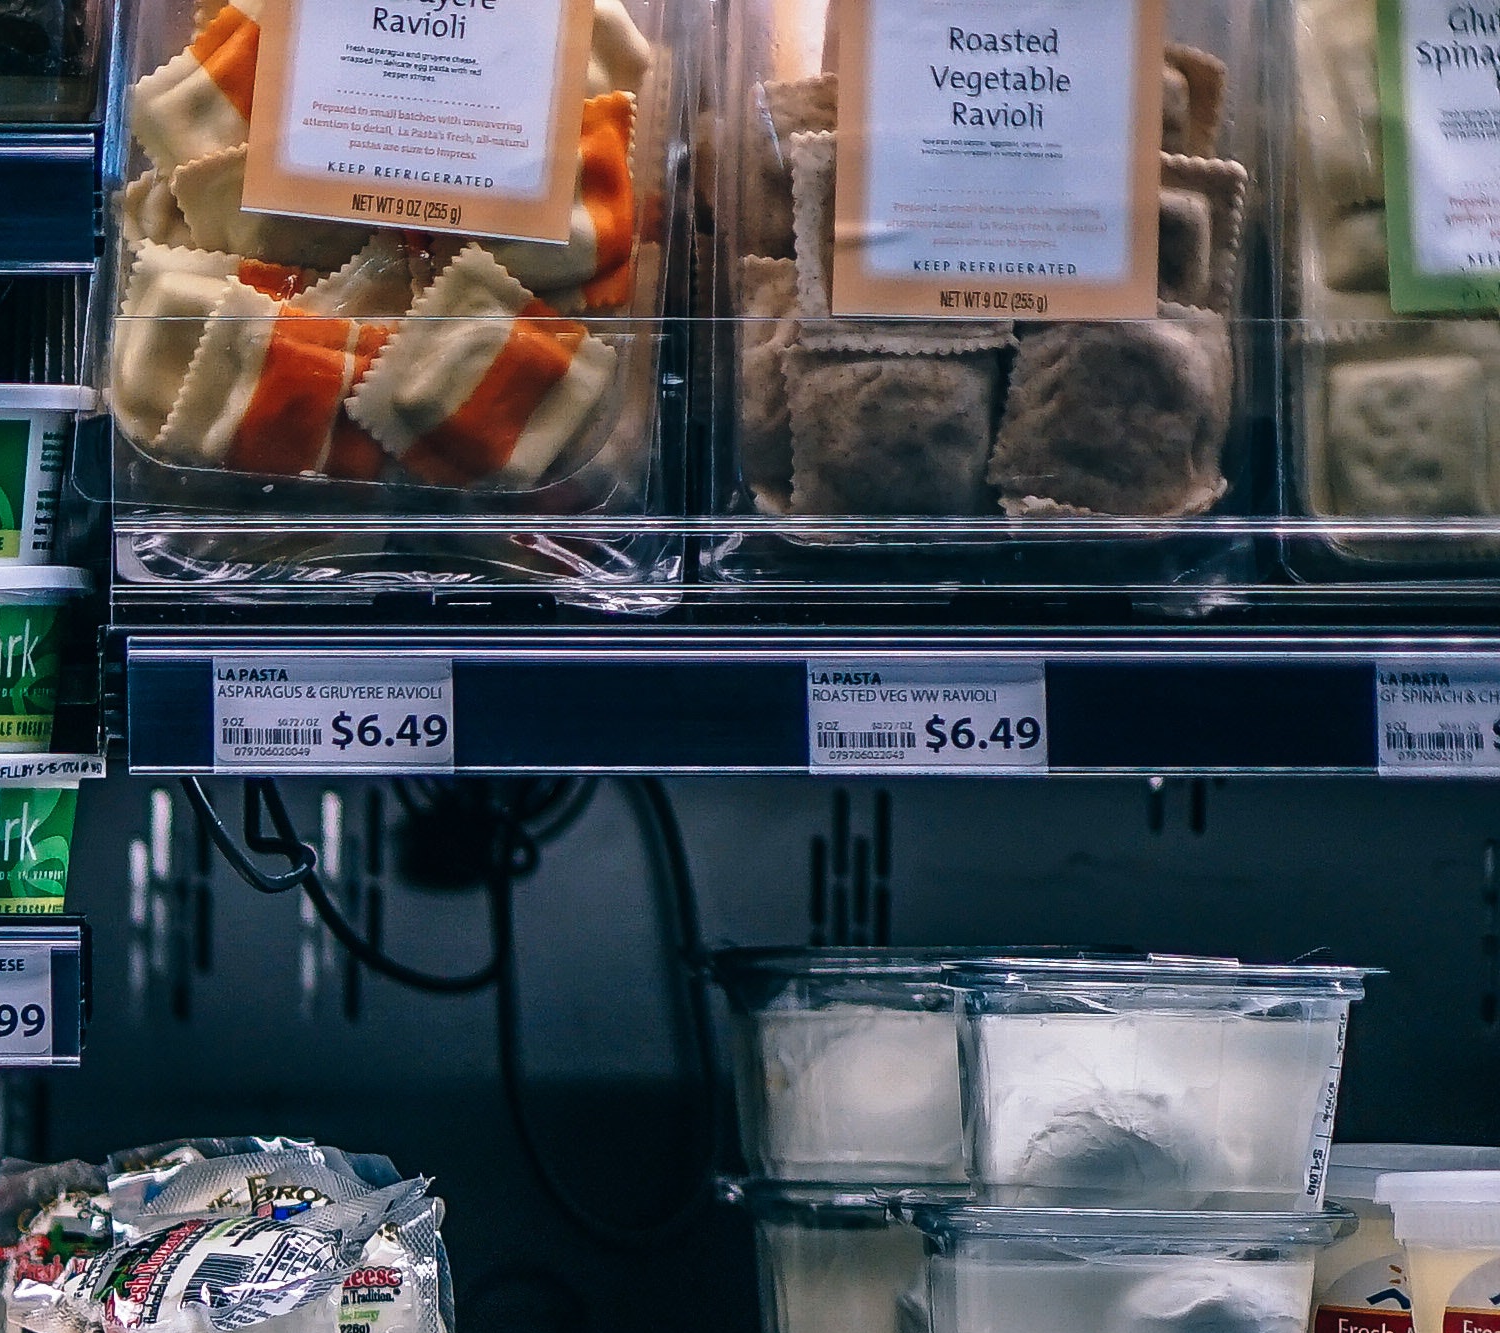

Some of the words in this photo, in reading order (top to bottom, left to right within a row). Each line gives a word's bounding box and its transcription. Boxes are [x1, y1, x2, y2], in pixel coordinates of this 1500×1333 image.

[949, 26, 1059, 55] Roasted
[929, 65, 1071, 98] Vegetable
[952, 101, 1043, 130] Ravioli
[913, 260, 951, 272] KEEP
[959, 260, 1077, 276] REFRIGERATED
[217, 668, 237, 682] LA
[238, 667, 289, 684] PASTA
[217, 684, 303, 699] ASPARAGUS
[305, 685, 317, 699] &
[319, 685, 384, 700] GRUYERE
[386, 683, 443, 700] RAVIOLI
[331, 710, 448, 751] $6.49
